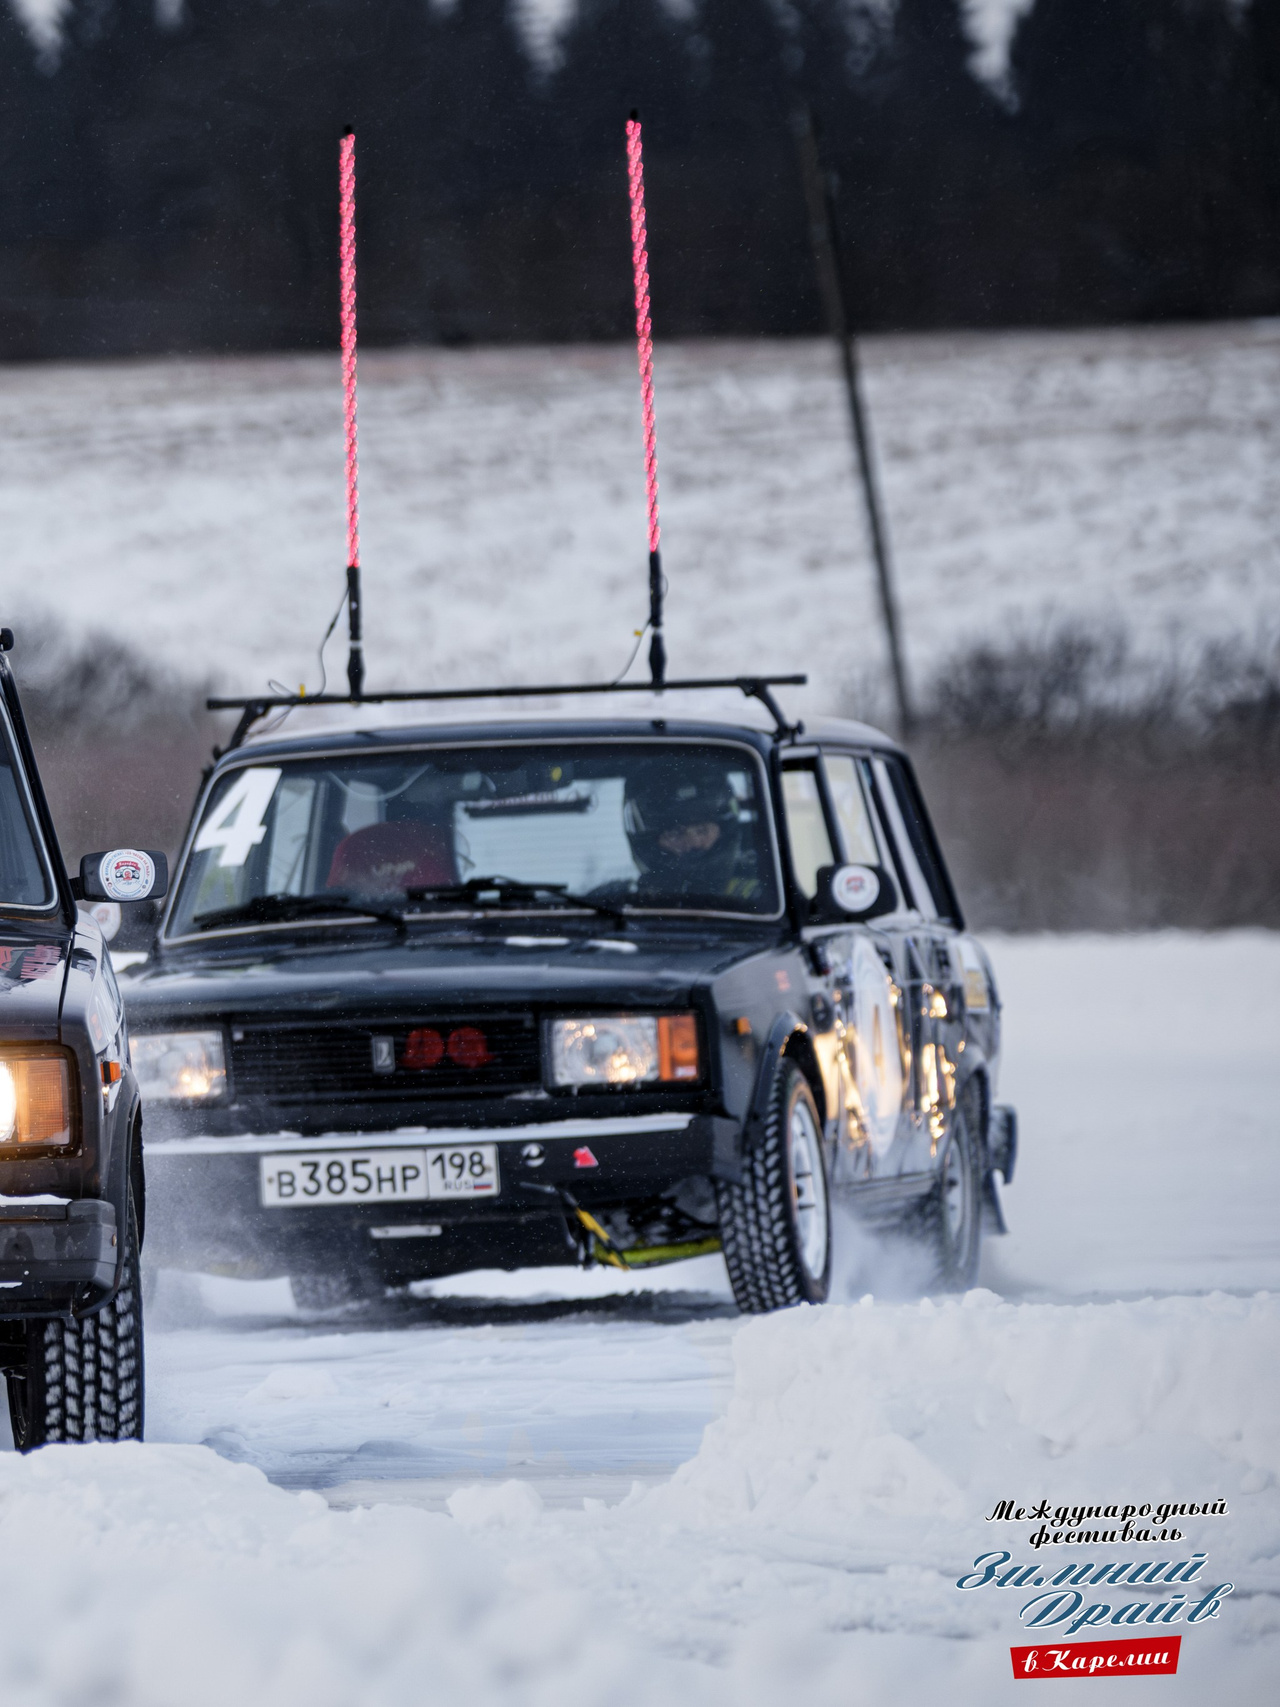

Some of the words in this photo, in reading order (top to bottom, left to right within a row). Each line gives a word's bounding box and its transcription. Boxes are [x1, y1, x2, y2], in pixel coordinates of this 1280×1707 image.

[194, 768, 282, 866] 4
[431, 1151, 487, 1180] 198
[443, 1179, 474, 1191] RUS
